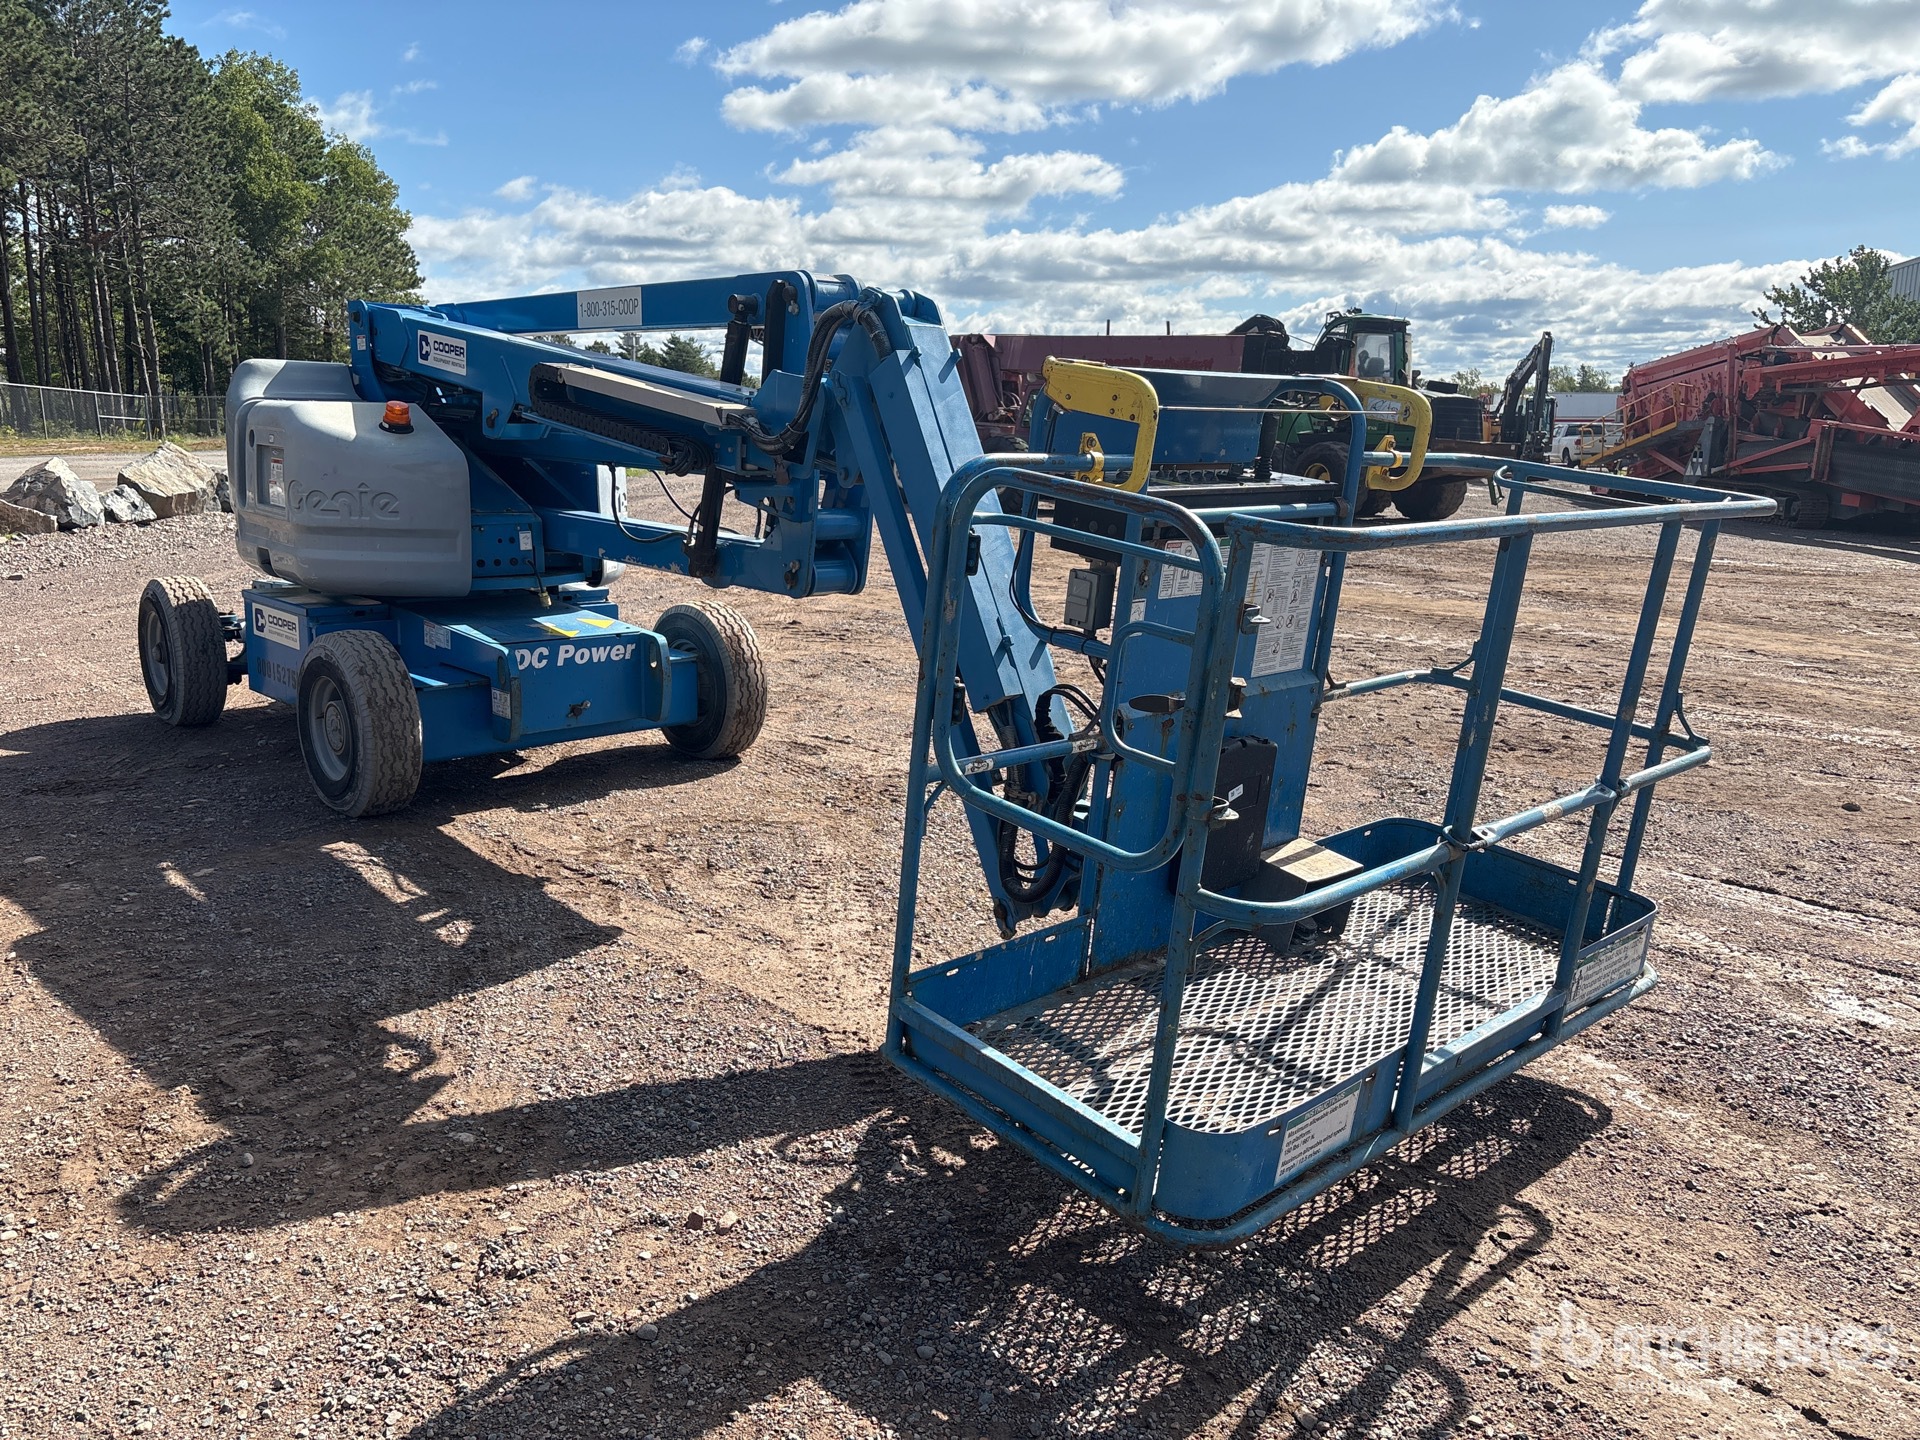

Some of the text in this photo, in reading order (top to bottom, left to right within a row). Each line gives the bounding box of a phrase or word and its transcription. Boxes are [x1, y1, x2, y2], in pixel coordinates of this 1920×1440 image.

[579, 297, 639, 318] 1-800-315-COOP
[433, 340, 465, 358] COOPER
[287, 478, 401, 521] Genie
[267, 614, 297, 633] COOPER
[514, 643, 636, 671] DC Power
